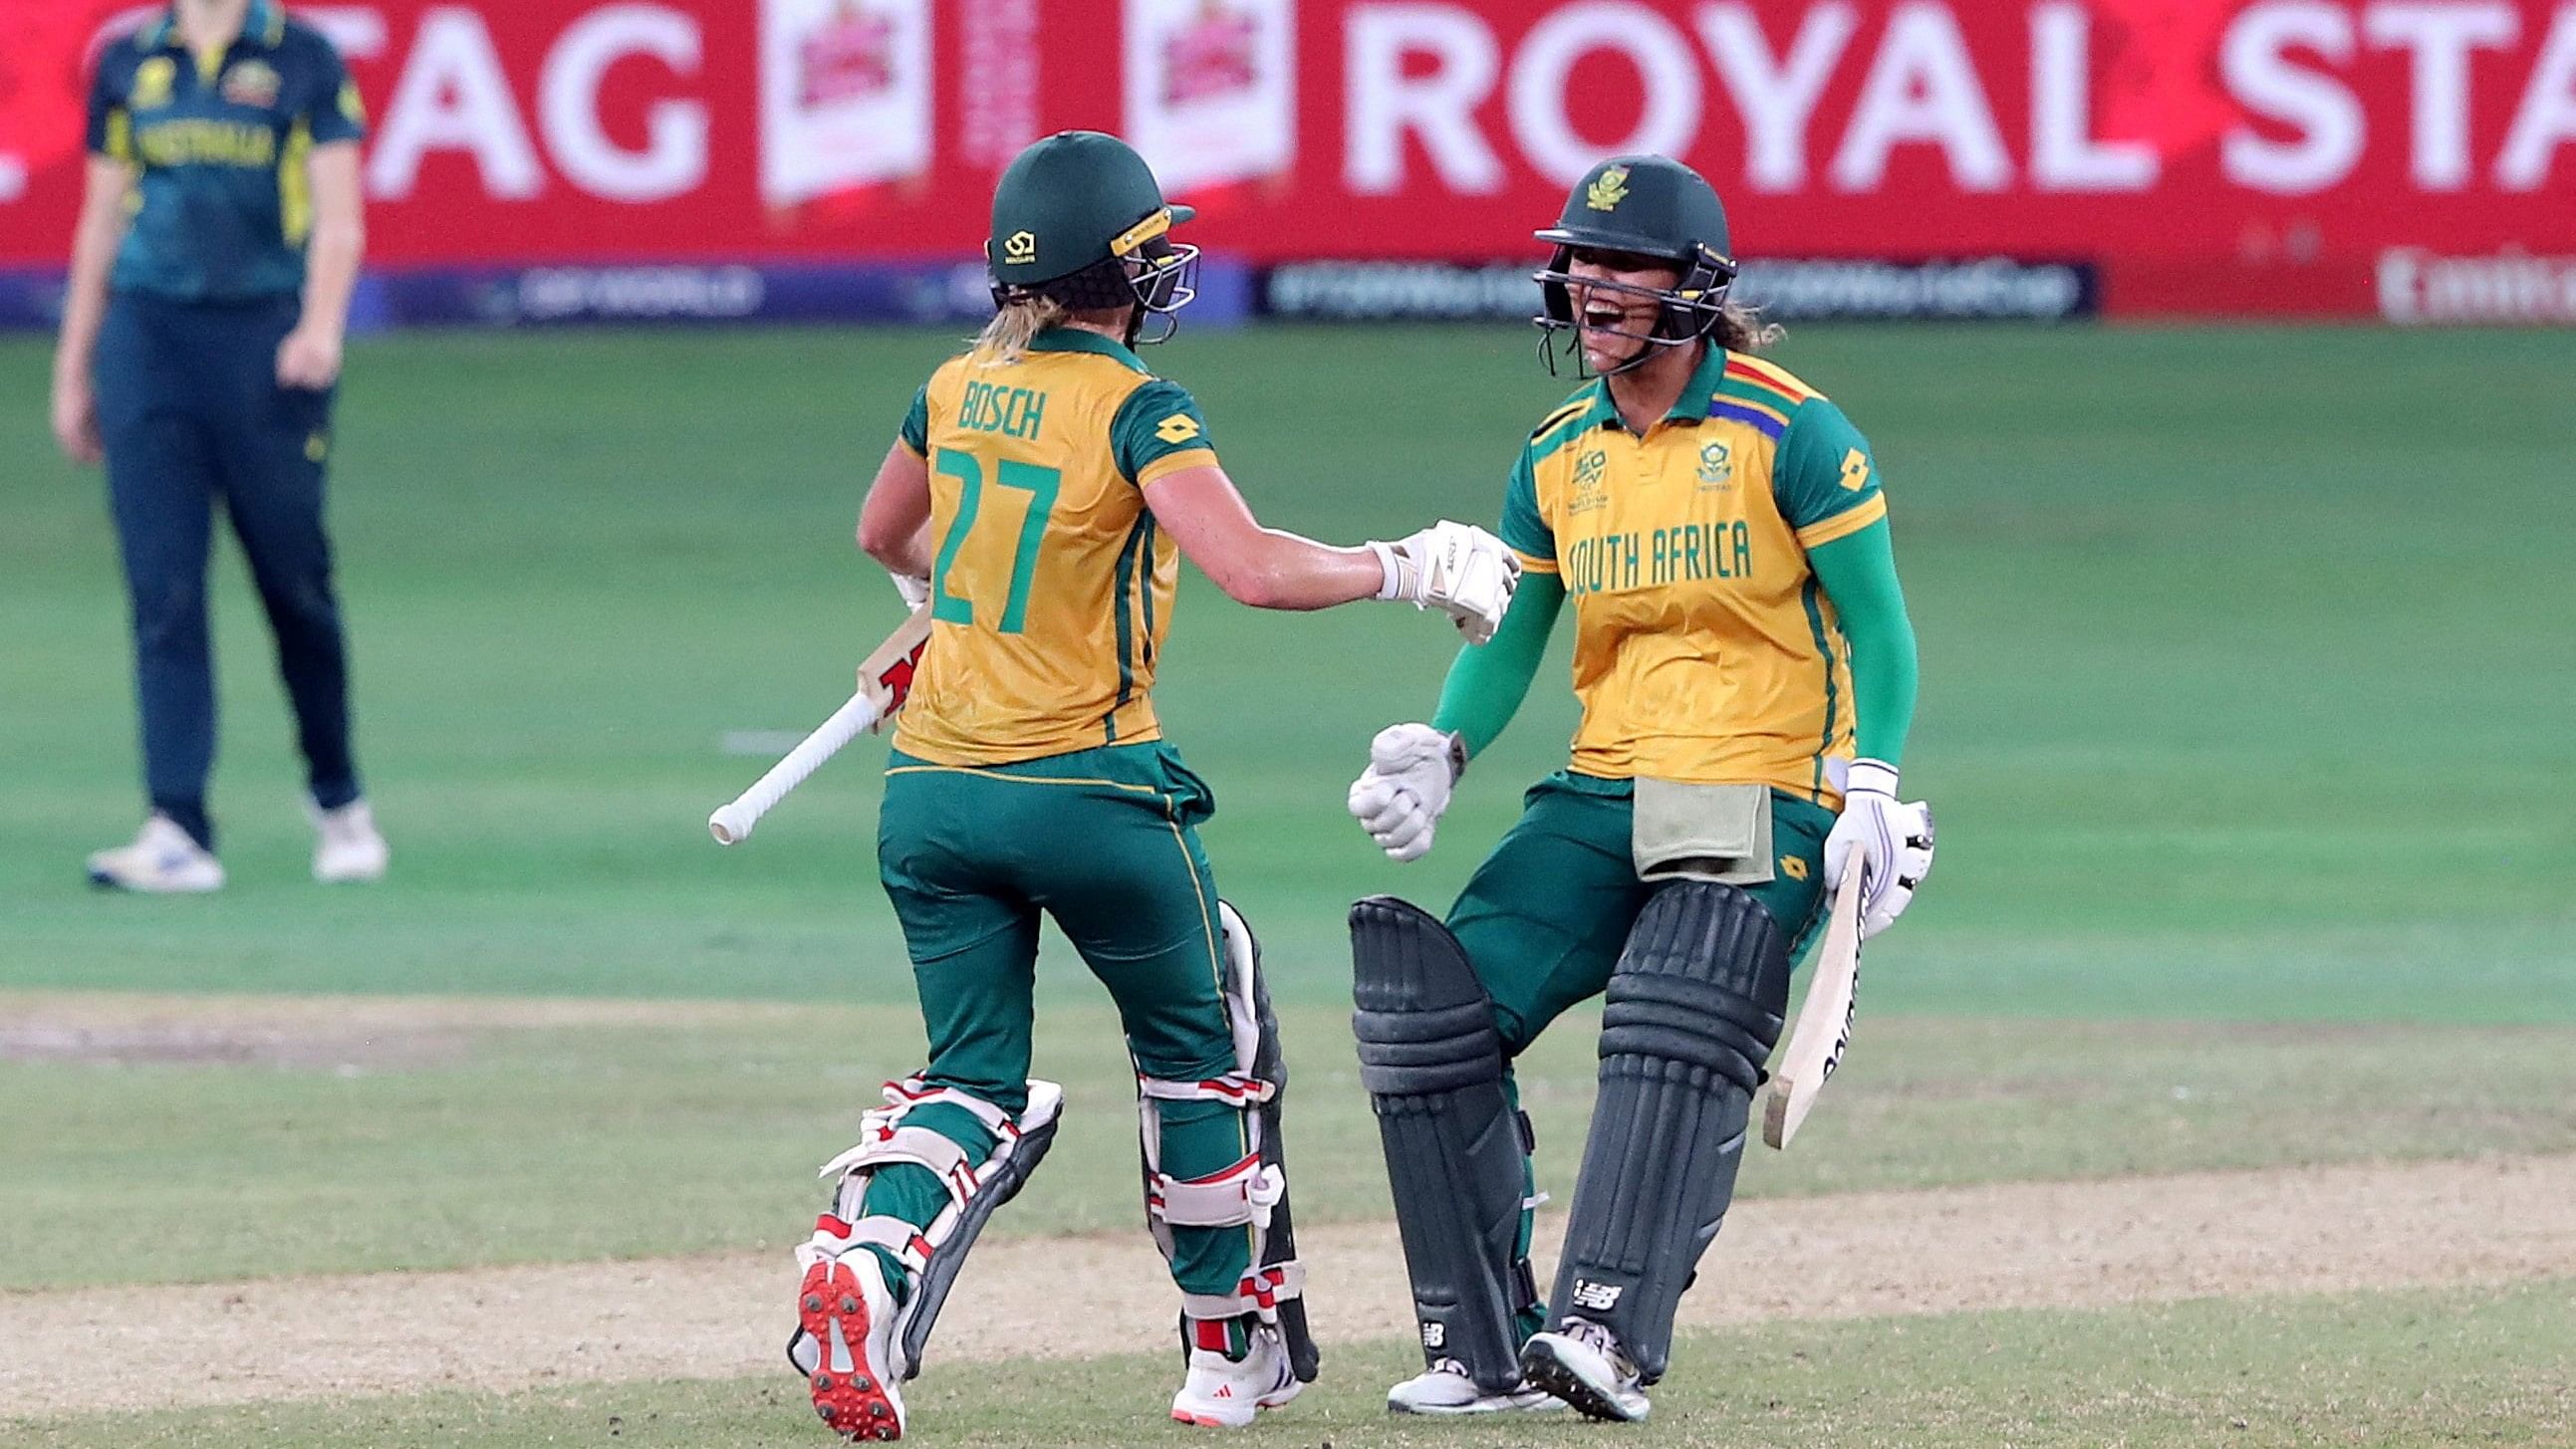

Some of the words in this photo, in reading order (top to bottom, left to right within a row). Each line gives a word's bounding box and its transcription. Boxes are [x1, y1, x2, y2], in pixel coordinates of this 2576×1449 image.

[1341, 0, 2162, 196] ROYAL
[958, 380, 1046, 440] BOSCH
[932, 447, 1062, 634] 27
[1653, 520, 1751, 584] AFRICA
